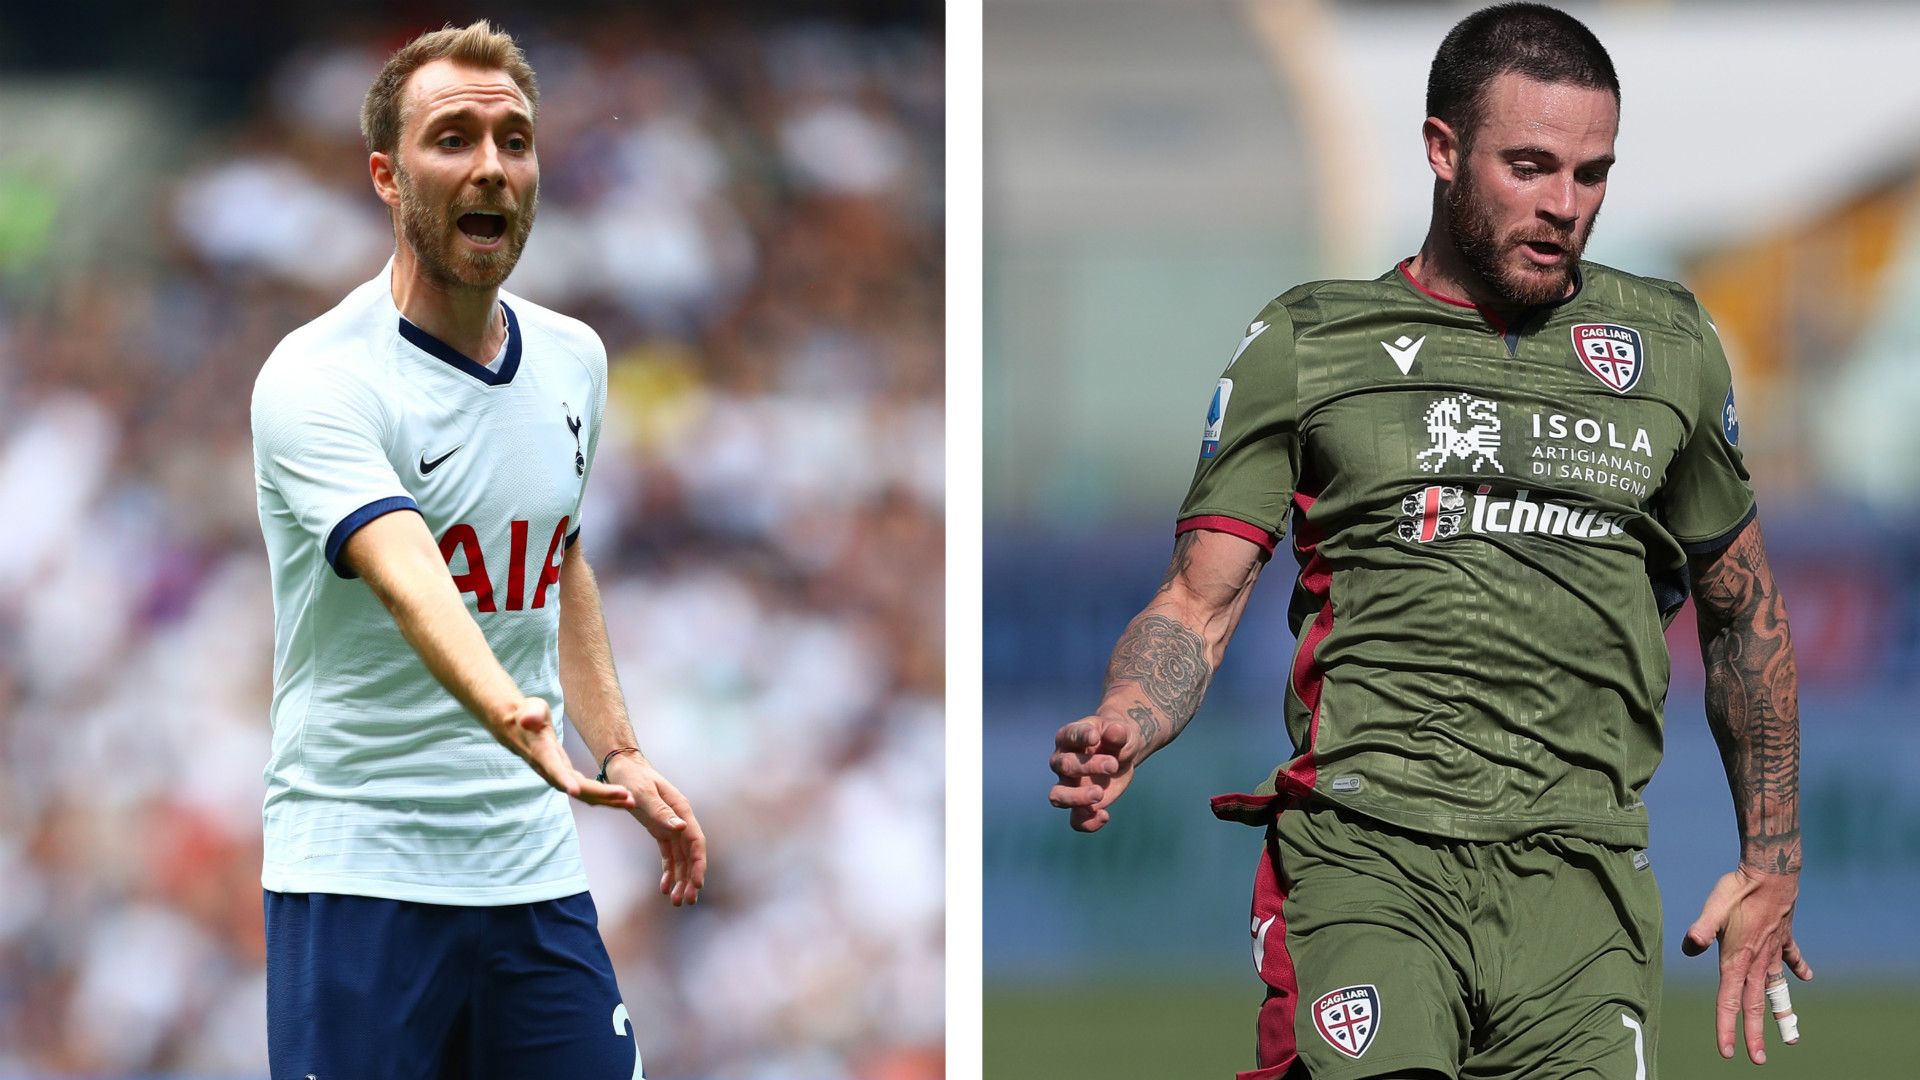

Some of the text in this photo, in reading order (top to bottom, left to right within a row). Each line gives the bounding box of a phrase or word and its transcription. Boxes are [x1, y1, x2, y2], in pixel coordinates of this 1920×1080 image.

[1581, 328, 1633, 343] CAGLIARI
[1532, 413, 1652, 457] ISOLA
[1531, 445, 1651, 479] ARTIGIANATO
[1532, 461, 1646, 498] DI SARDEGNA
[438, 515, 570, 613] AIA
[1320, 989, 1369, 1010] CAGLIARI
